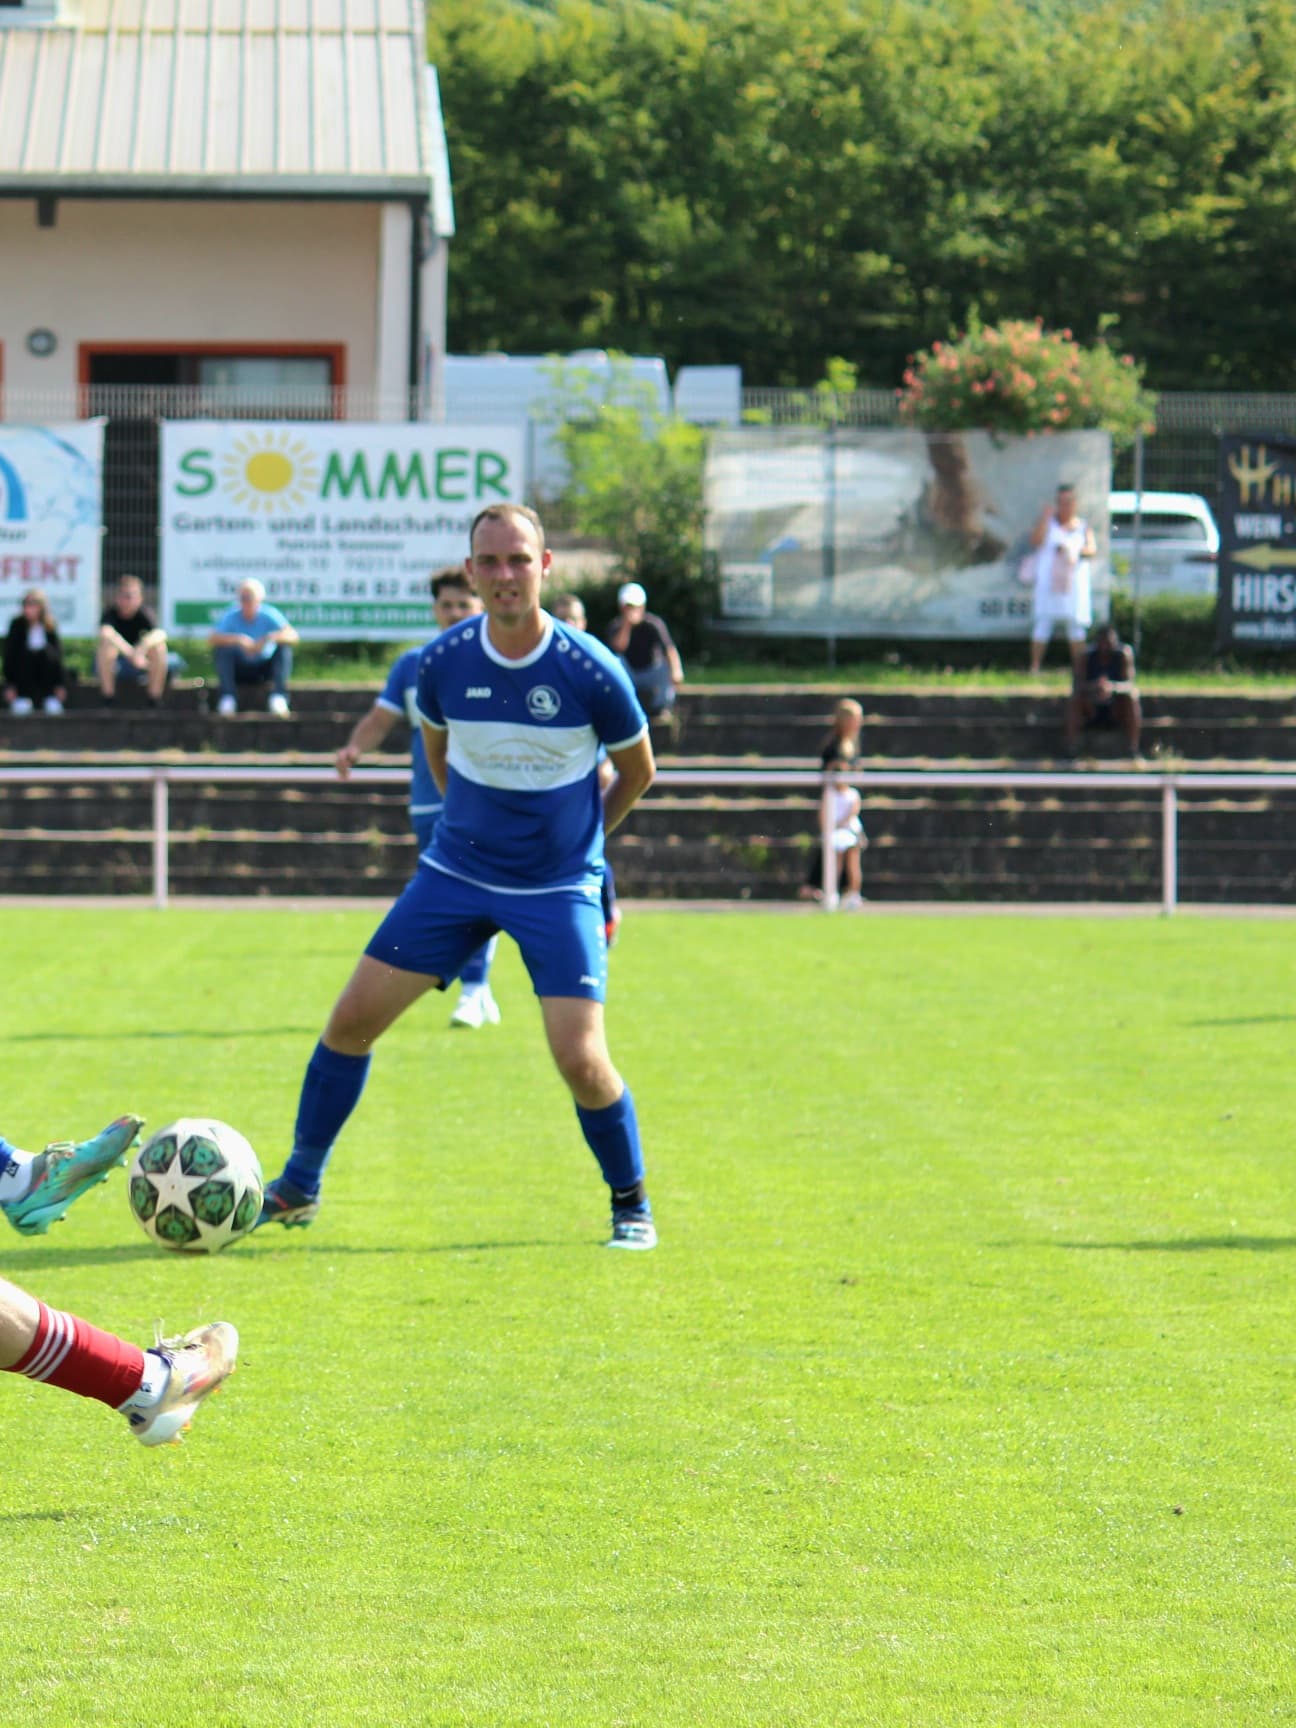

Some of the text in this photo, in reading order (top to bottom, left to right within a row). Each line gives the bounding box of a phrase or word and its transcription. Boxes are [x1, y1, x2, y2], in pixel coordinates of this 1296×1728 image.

[267, 514, 315, 533] und
[1231, 573, 1296, 614] HIRS
[465, 686, 492, 699] JAKO
